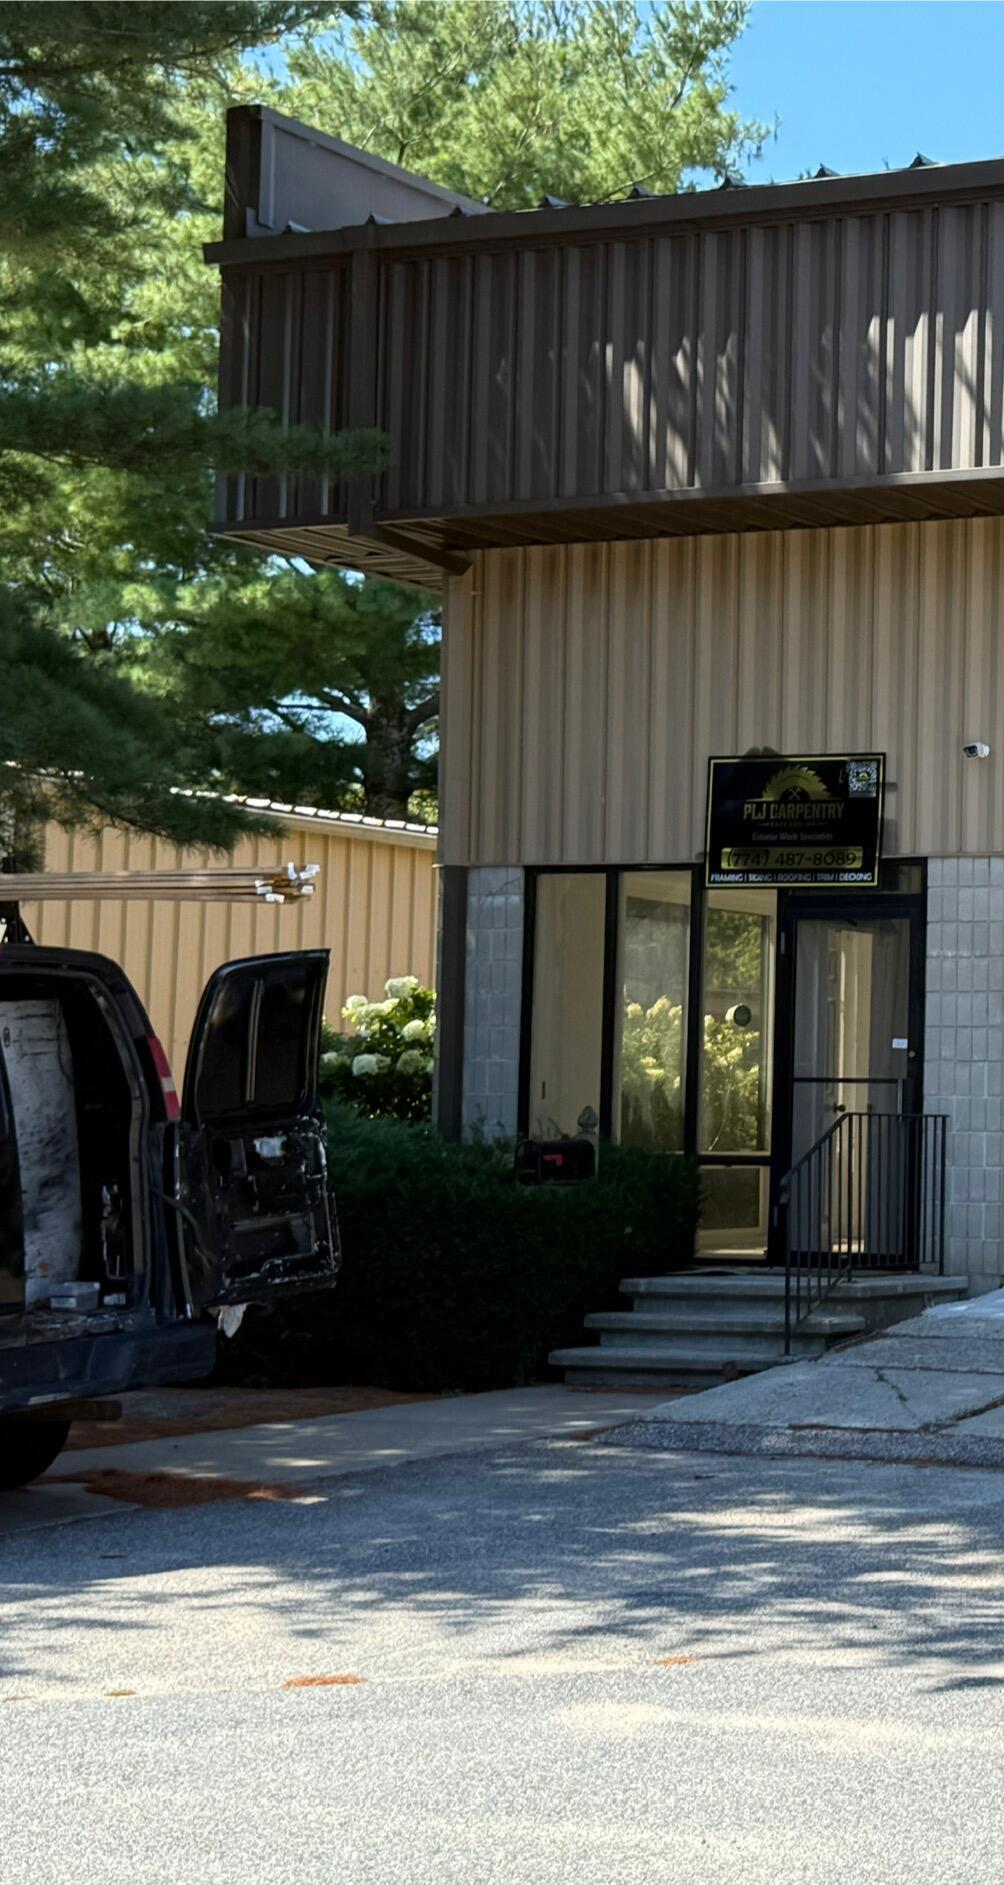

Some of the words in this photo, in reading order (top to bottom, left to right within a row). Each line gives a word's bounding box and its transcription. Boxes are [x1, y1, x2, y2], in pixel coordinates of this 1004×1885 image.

[743, 804, 767, 820] PLJ
[770, 802, 845, 820] CARPENTRY
[727, 849, 769, 867] (774)
[775, 852, 857, 866] 487-8089
[711, 873, 743, 882] FRAMING
[748, 873, 773, 882] SIDING
[777, 873, 811, 882] ROOFING
[817, 873, 834, 881] TRIM
[839, 872, 872, 881] DECKING
